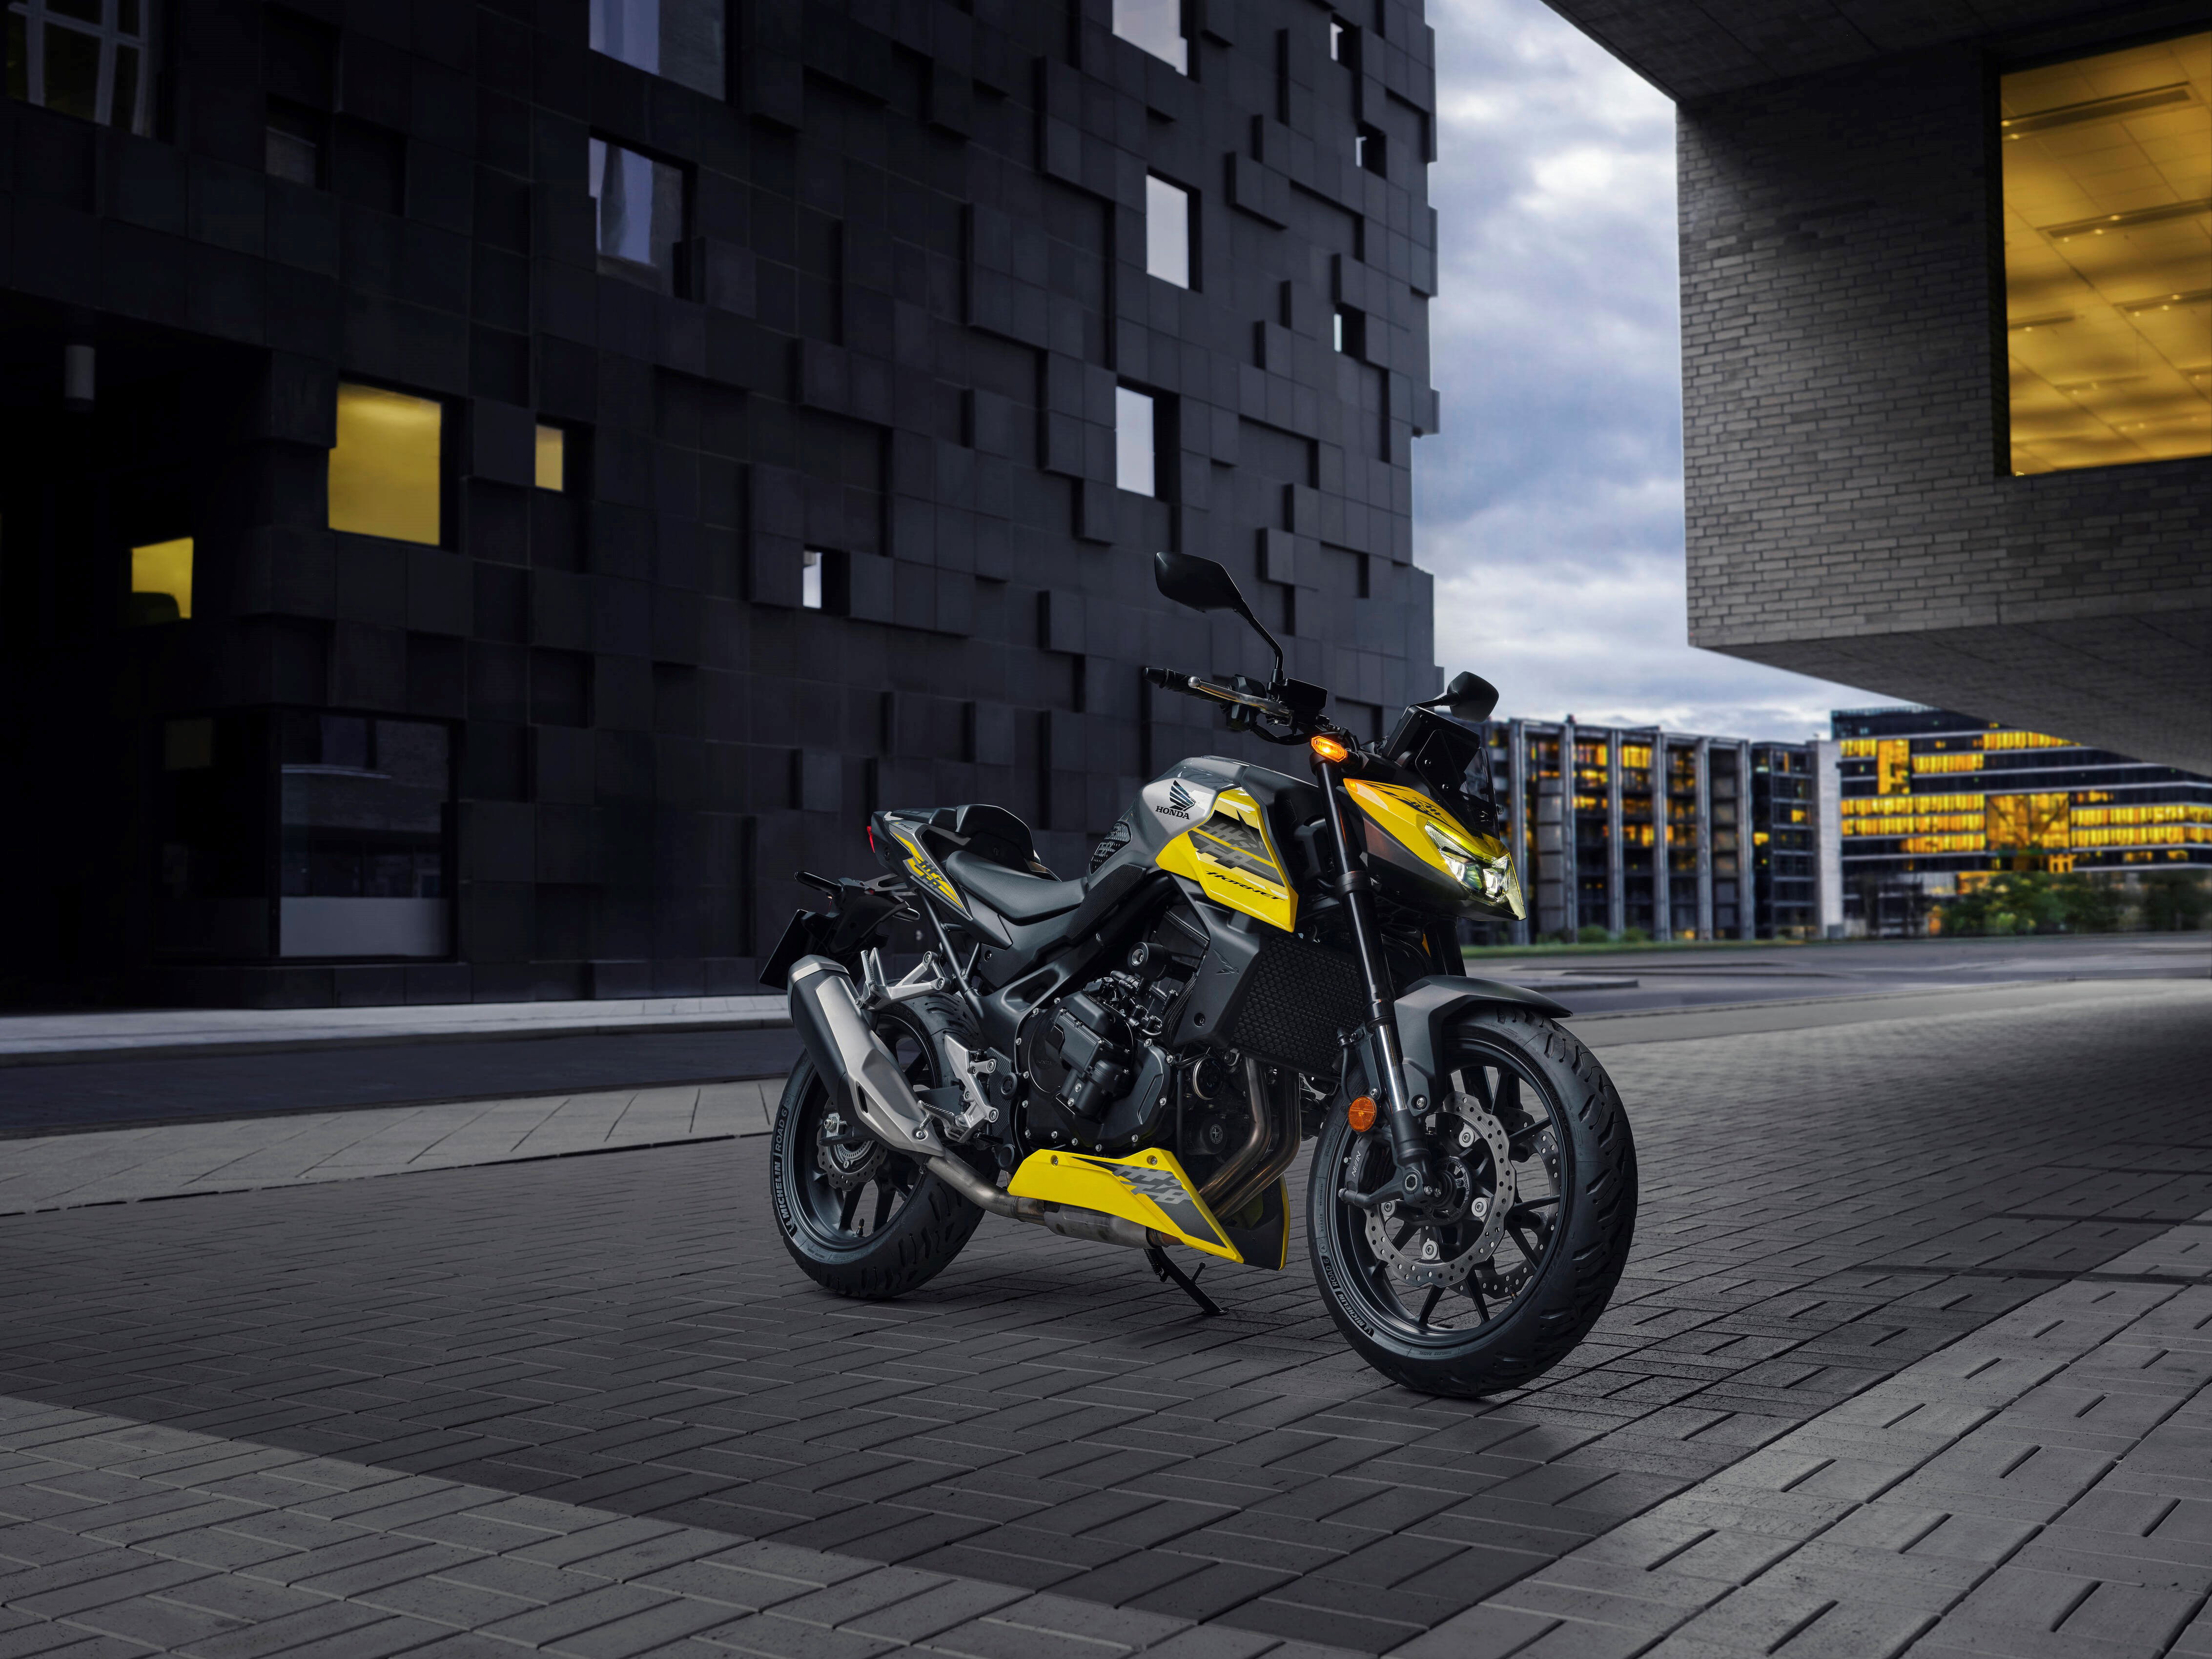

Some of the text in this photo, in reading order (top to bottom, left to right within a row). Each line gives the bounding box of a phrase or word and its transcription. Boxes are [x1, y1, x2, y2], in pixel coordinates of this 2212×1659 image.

[1155, 806, 1190, 820] HONDA
[776, 1120, 785, 1152] ROAD
[773, 1161, 790, 1218] MICHELIN
[1326, 1267, 1339, 1287] ROAD
[1337, 1294, 1366, 1326] MICHELIN
